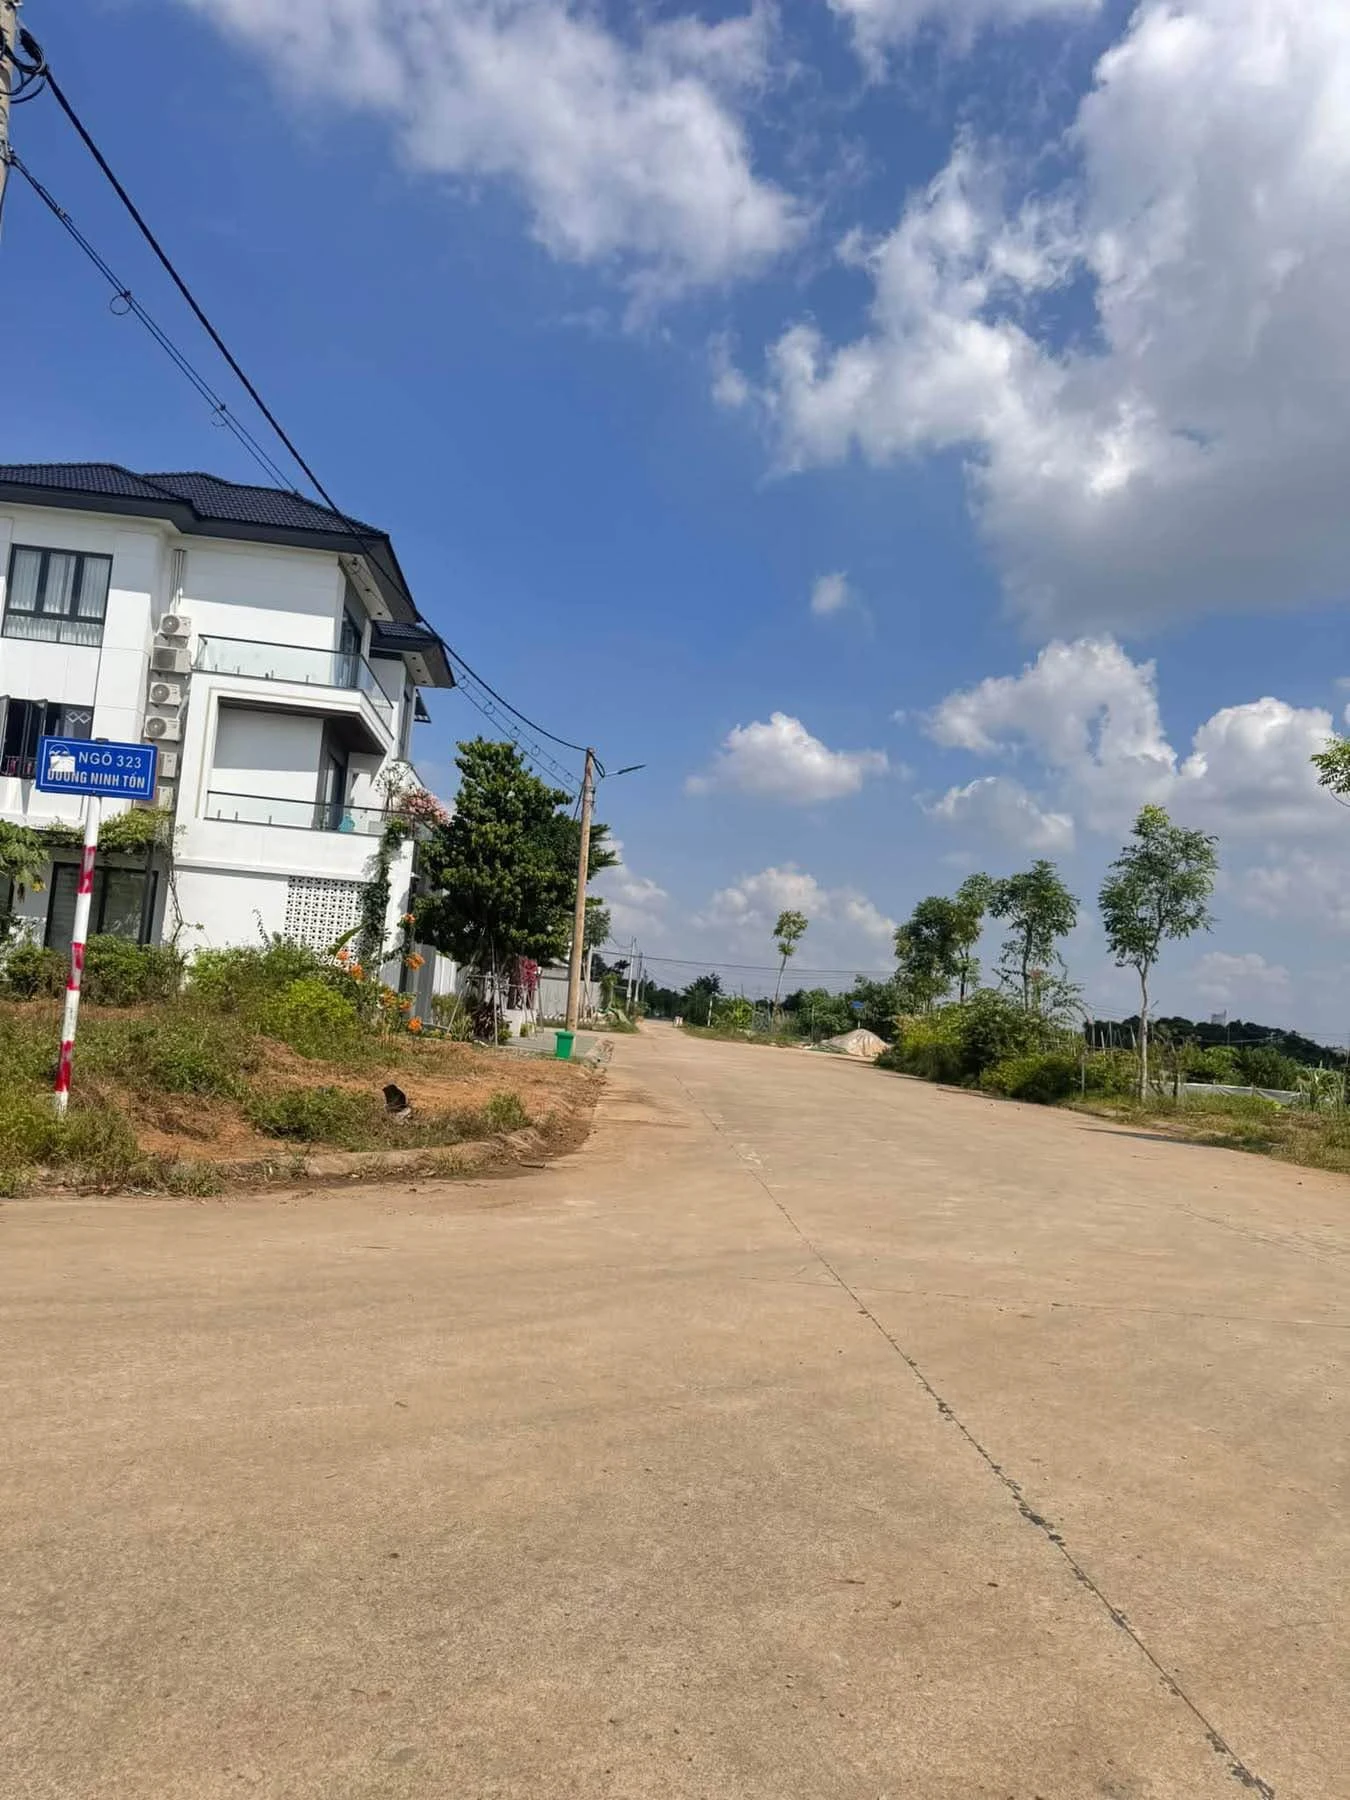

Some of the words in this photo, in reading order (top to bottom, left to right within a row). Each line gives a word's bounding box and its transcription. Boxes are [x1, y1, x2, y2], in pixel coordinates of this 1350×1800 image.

[78, 751, 113, 766] NGÕ
[116, 755, 142, 769] 323
[90, 771, 120, 787] NINH
